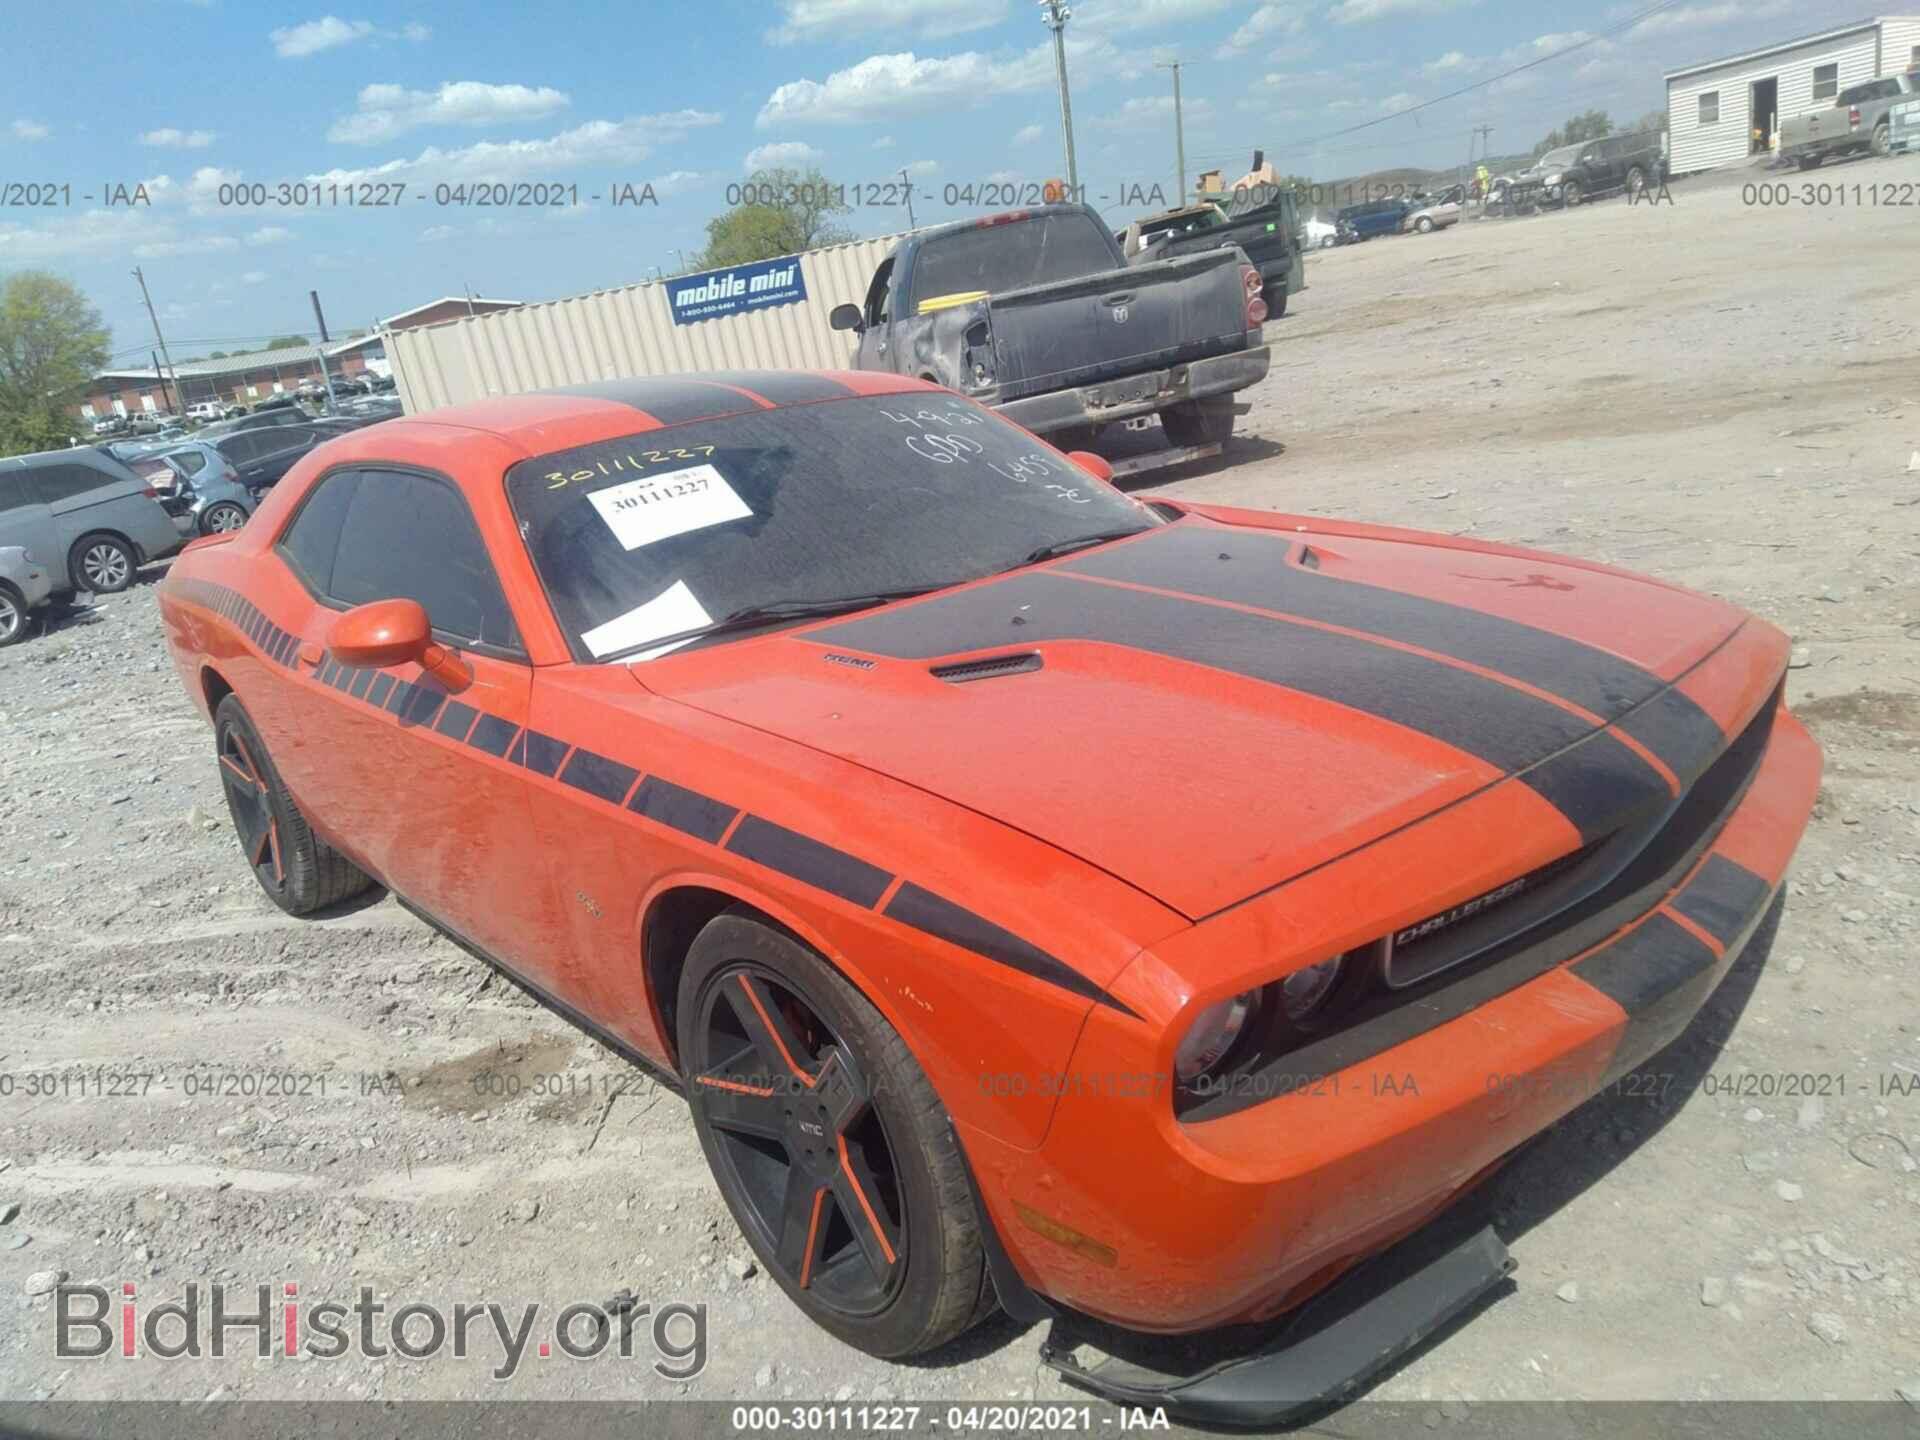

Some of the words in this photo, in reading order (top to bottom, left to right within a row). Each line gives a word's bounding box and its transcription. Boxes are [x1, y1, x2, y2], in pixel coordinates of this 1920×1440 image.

[676, 273, 746, 307] mobile
[750, 265, 795, 293] mini
[544, 446, 715, 489] 30111227
[612, 479, 710, 513] 30111227
